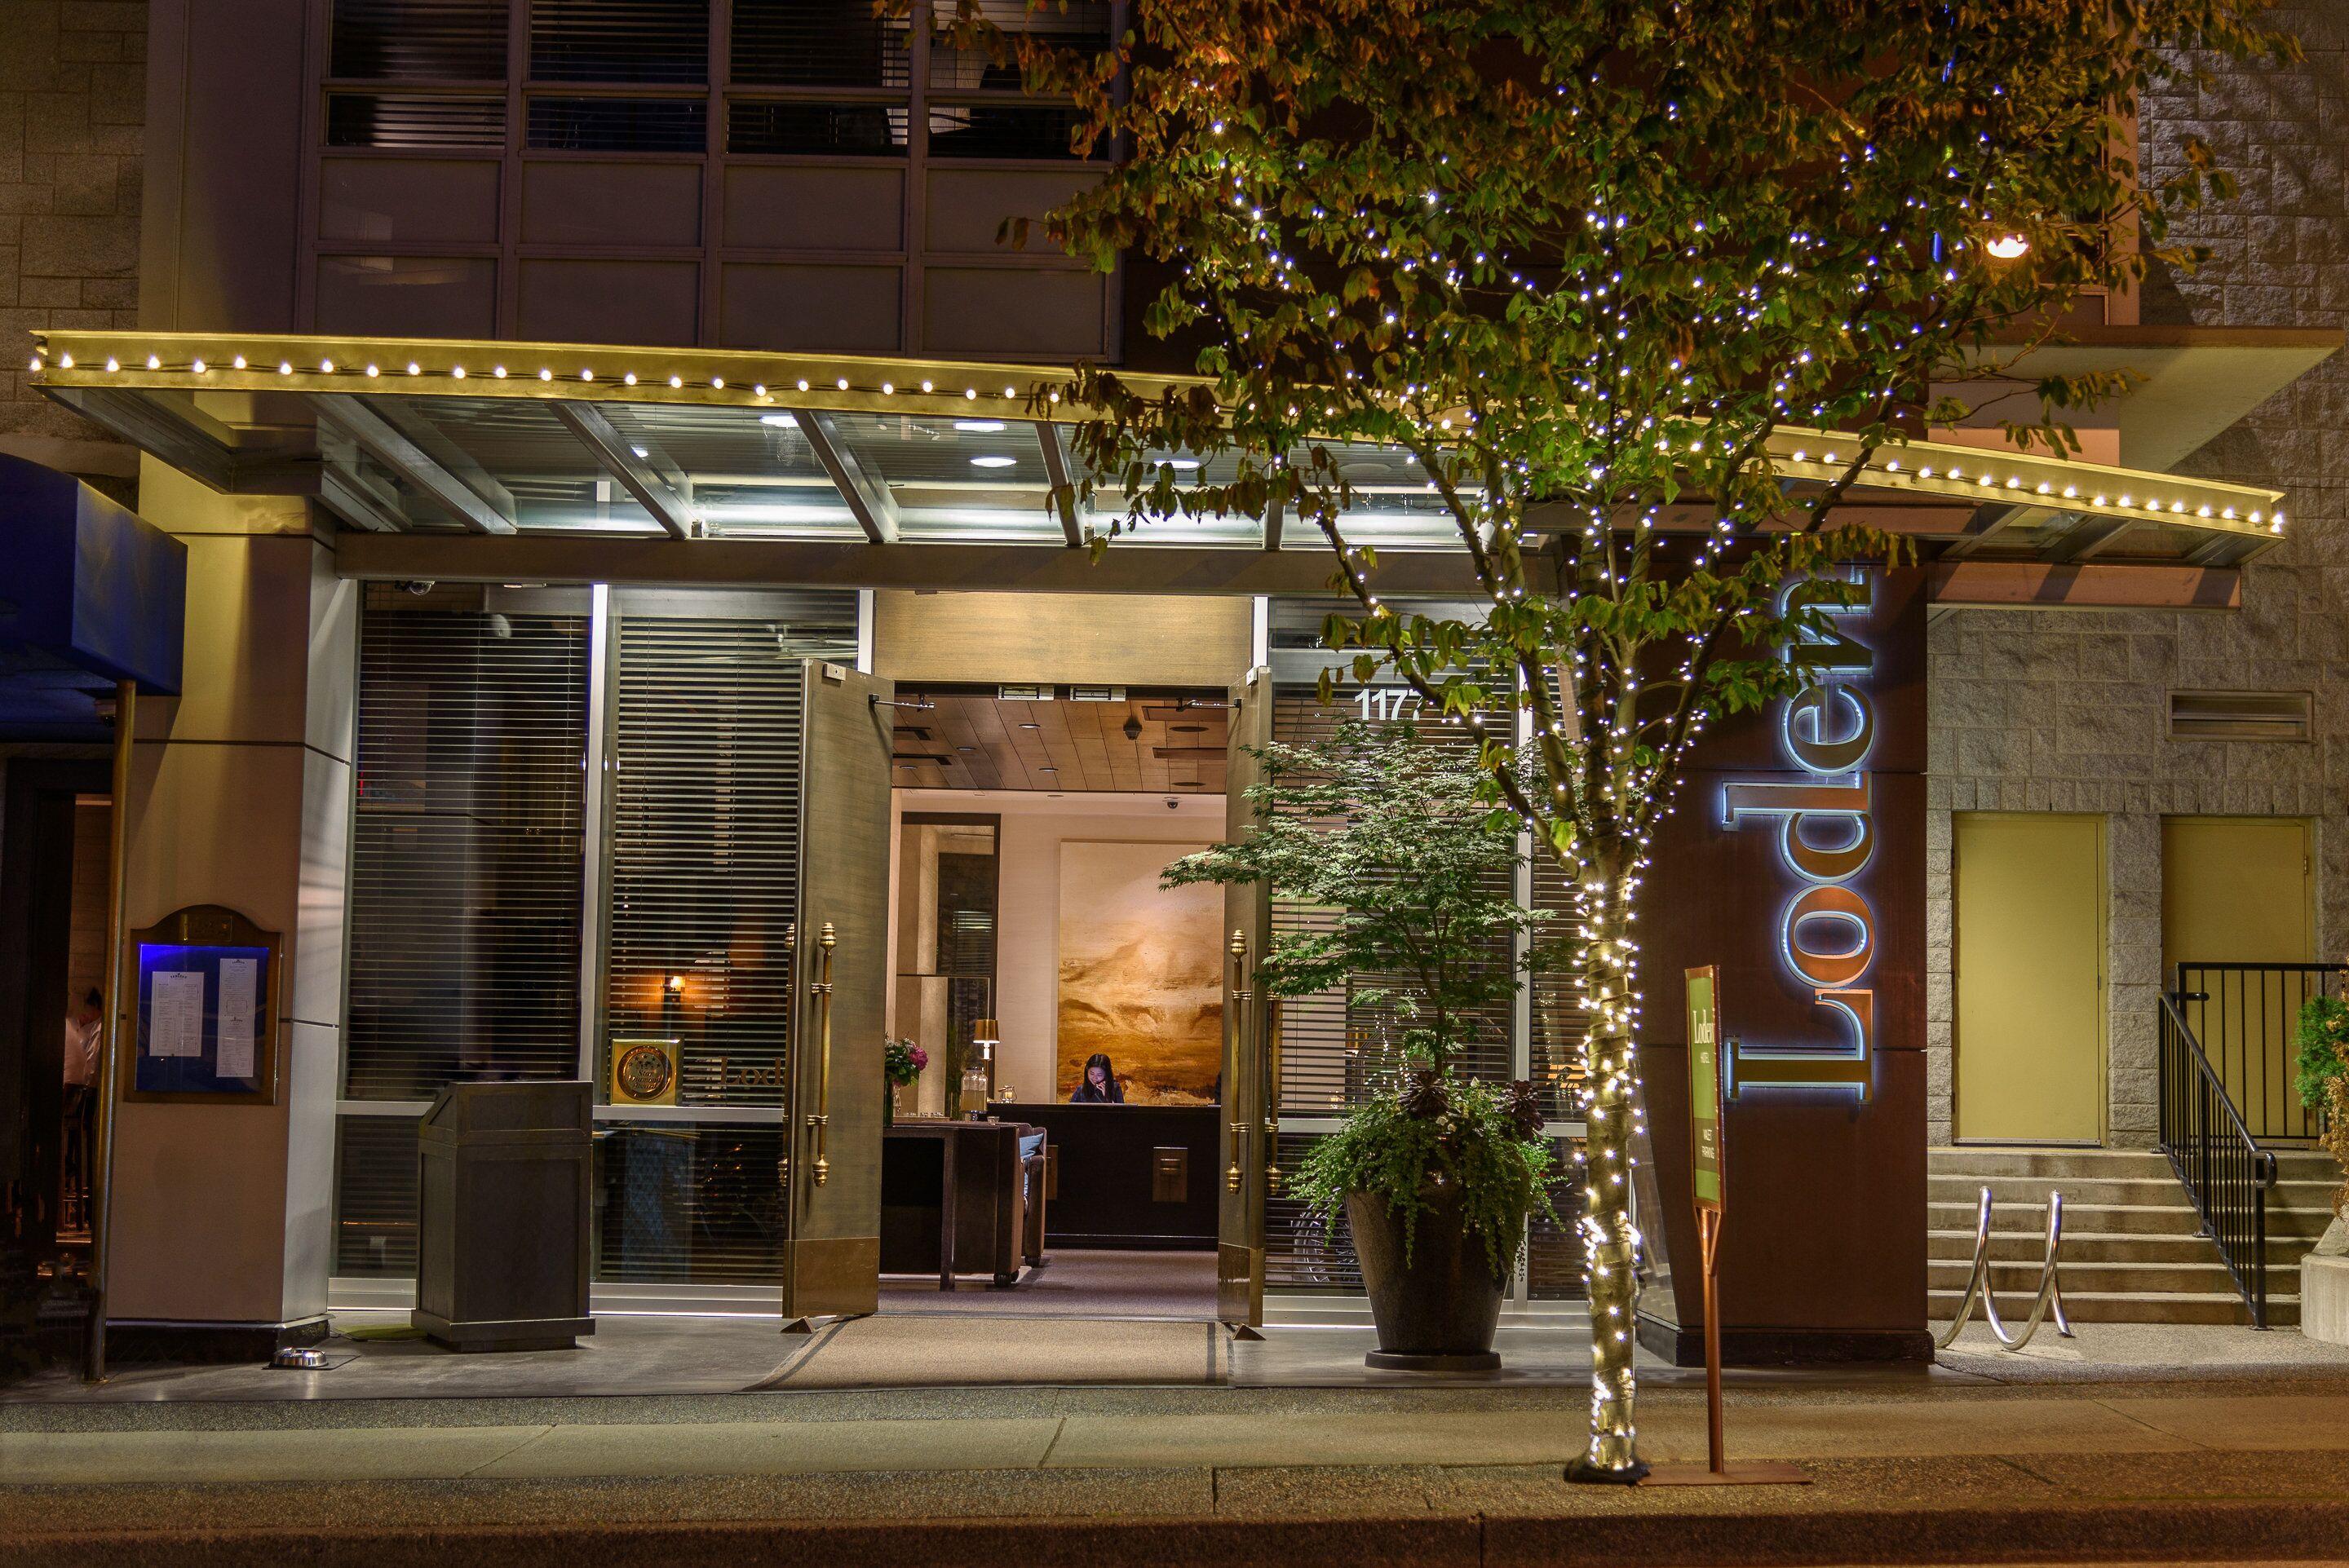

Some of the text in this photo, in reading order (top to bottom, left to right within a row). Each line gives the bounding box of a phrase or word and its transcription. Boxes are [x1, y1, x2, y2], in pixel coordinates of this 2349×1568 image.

[1354, 688, 1423, 721] 1177
[1722, 568, 1874, 1103] Loden
[1692, 1009, 1714, 1044] Loden
[1702, 1129, 1713, 1142] VALET
[1701, 1146, 1715, 1159] PARKING
